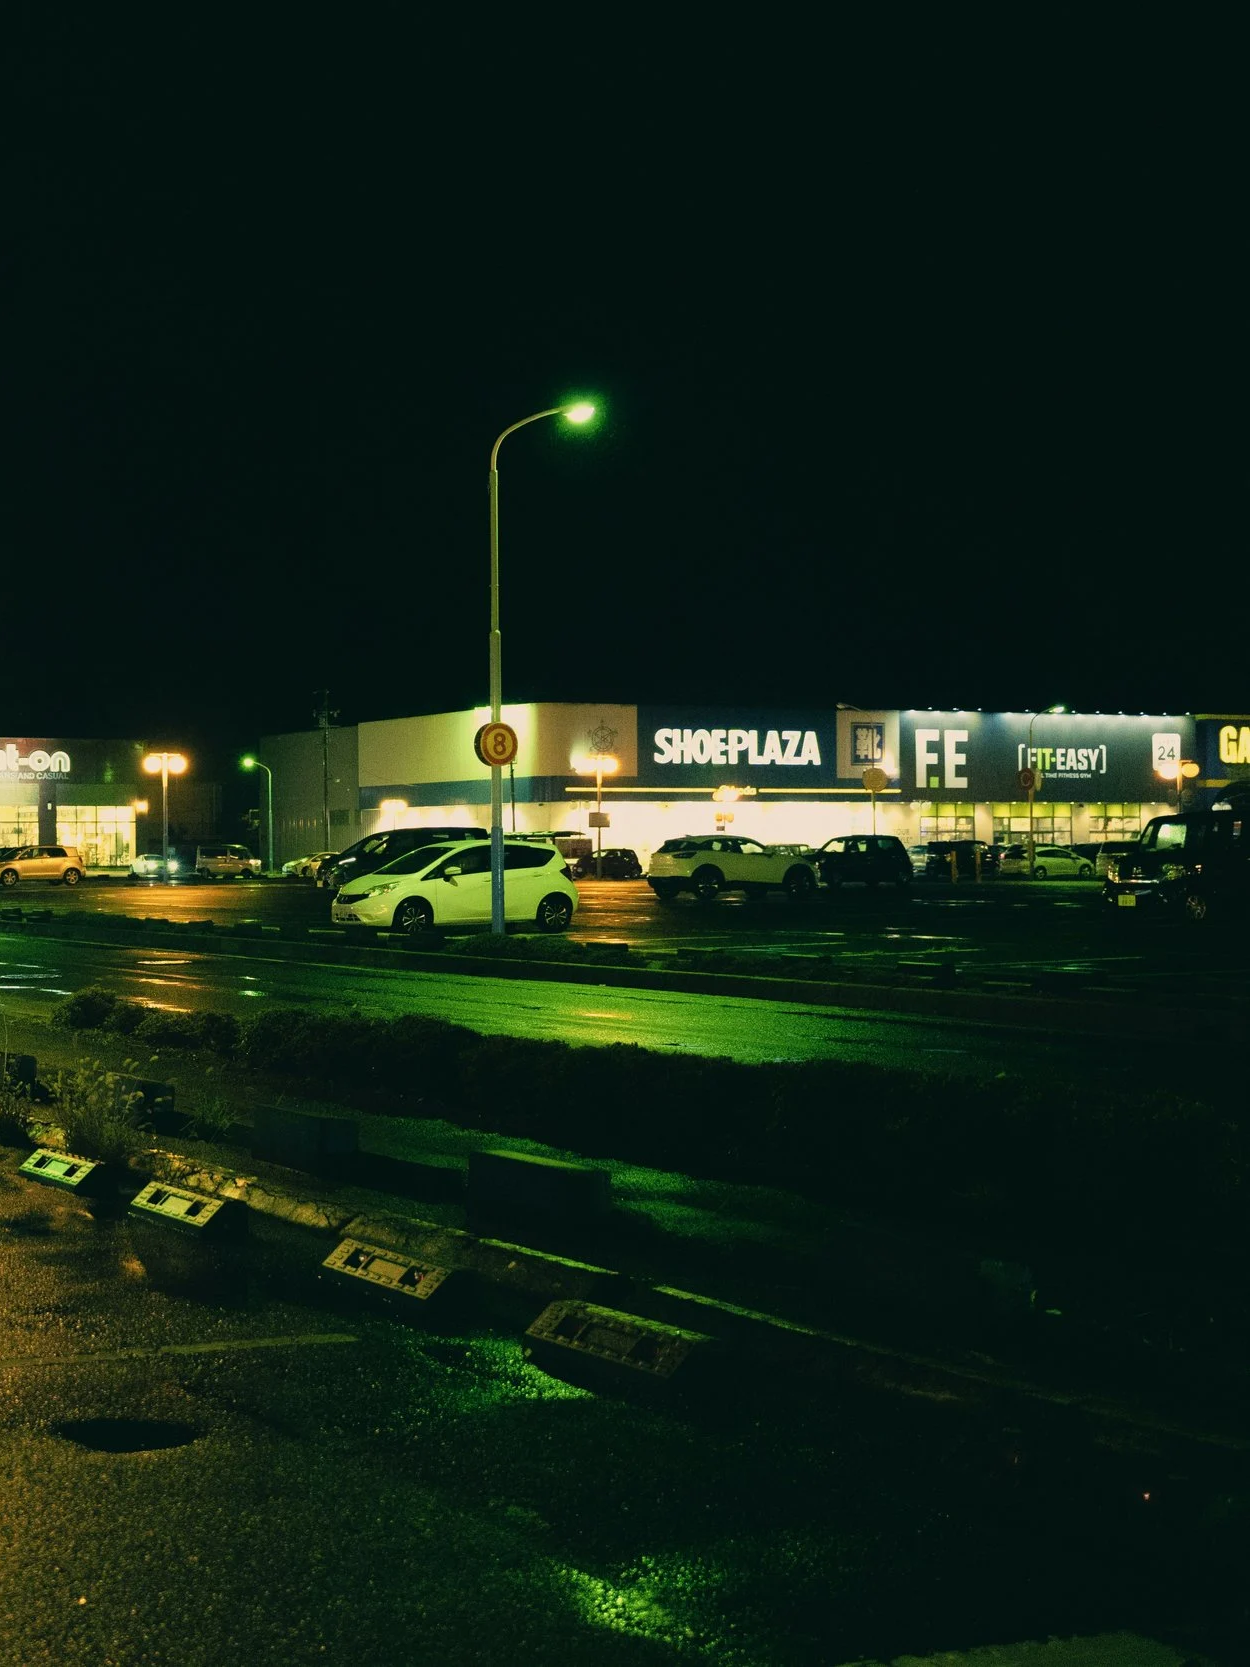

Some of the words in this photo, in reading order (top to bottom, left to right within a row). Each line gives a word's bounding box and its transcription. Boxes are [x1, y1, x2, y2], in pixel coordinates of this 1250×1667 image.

[493, 732, 507, 756] 8
[1158, 745, 1176, 761] 24
[18, 771, 36, 780] AND
[36, 771, 69, 780] CASUAL
